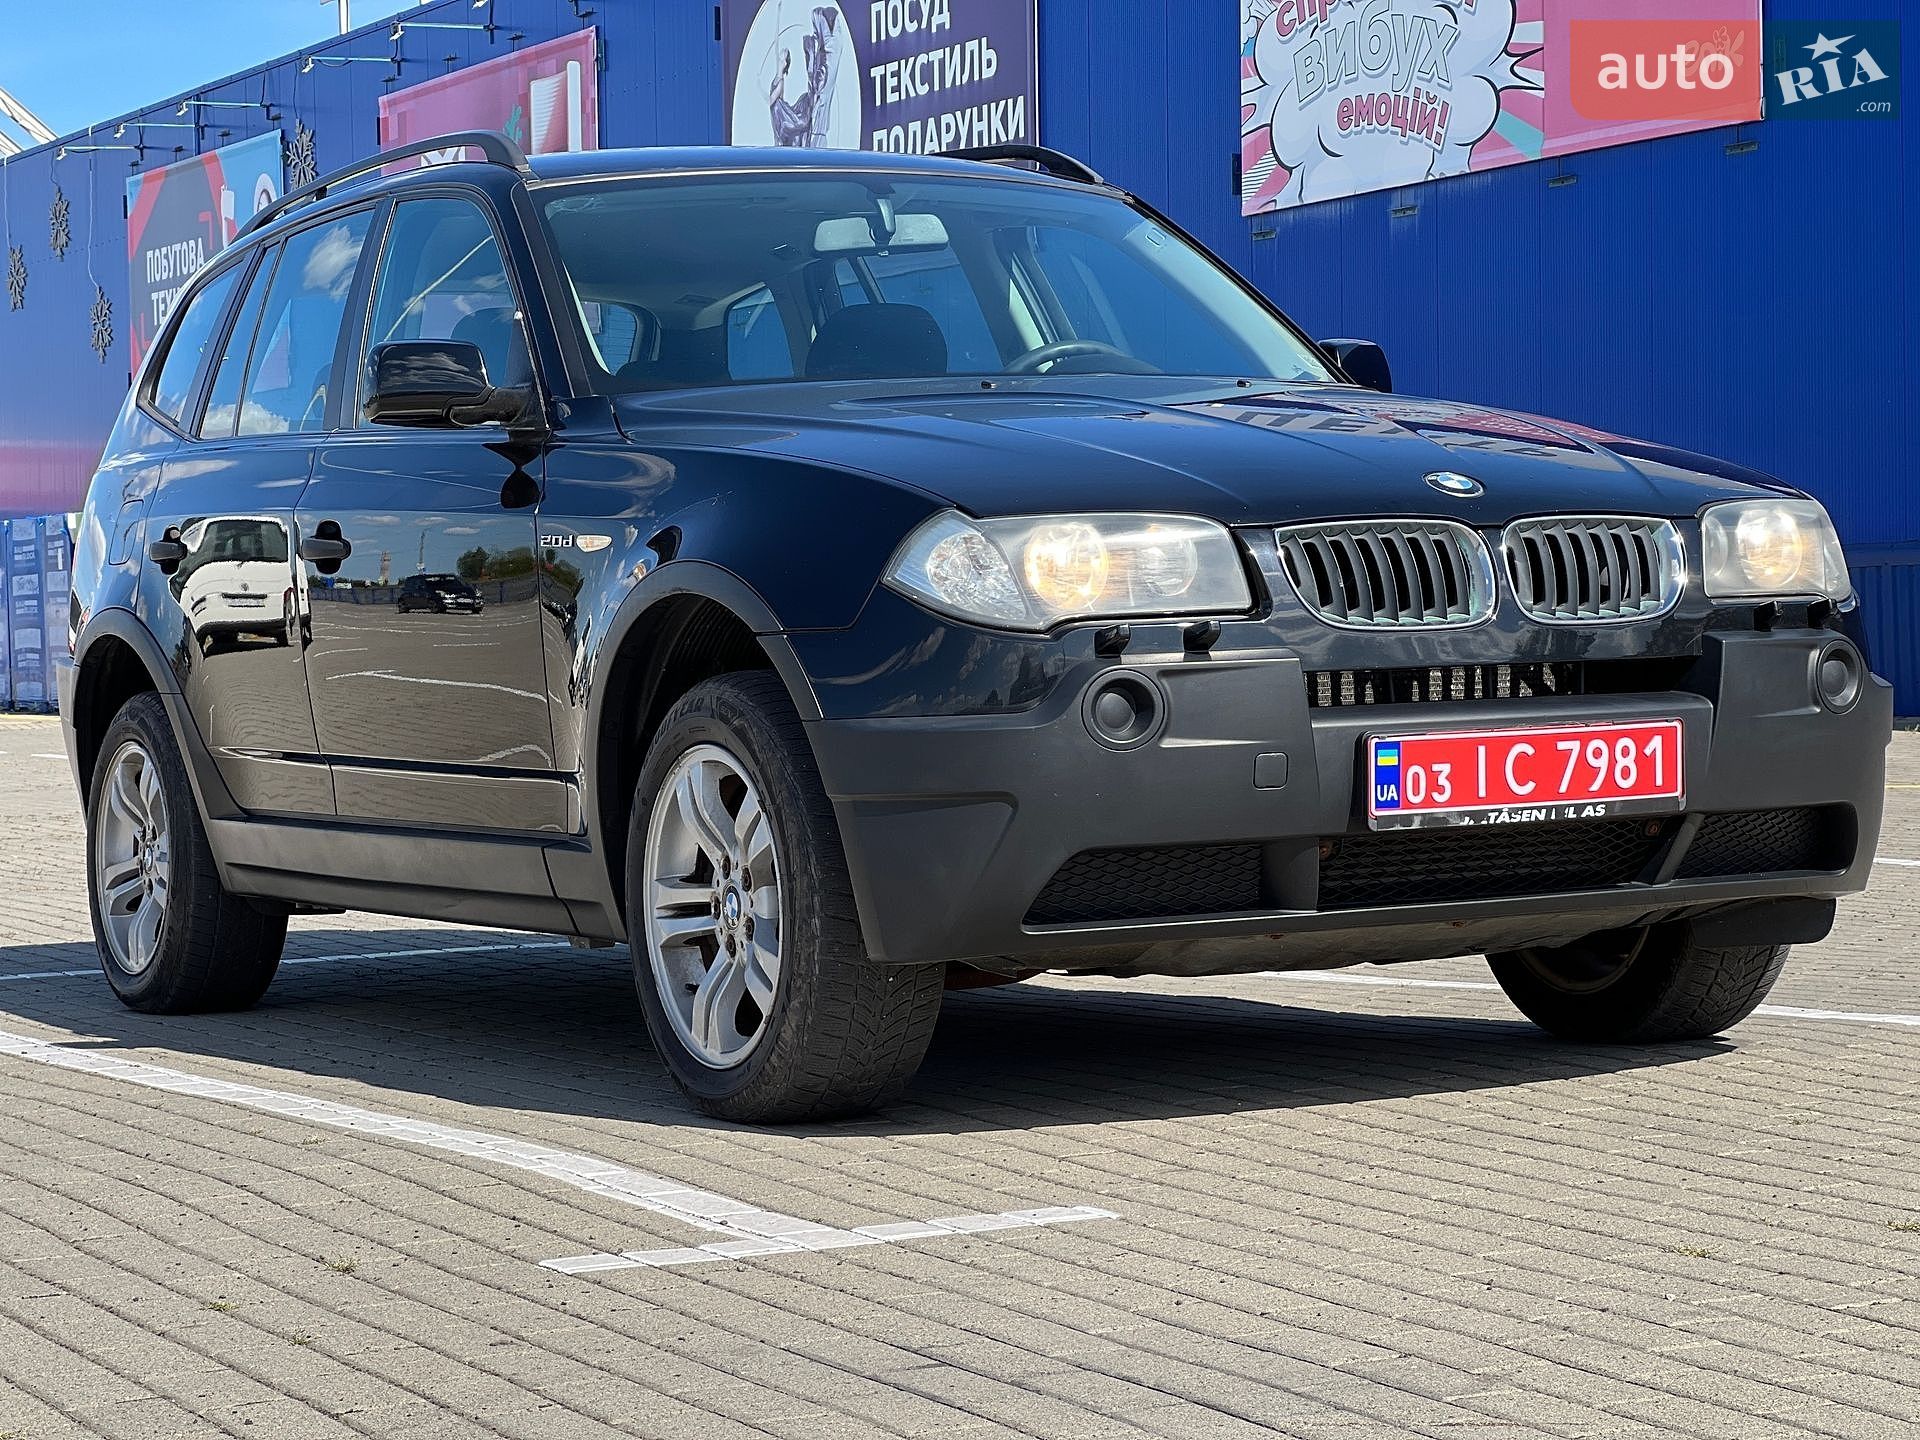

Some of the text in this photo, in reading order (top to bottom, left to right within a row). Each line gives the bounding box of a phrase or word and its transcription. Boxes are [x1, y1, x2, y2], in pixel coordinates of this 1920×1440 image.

[871, 0, 950, 43] ПОСУД
[870, 37, 998, 107] ТЕКСТИЛЬ
[1336, 87, 1450, 146] емоцій!
[146, 237, 205, 283] ПОБУТОВА
[540, 534, 573, 547] 20d
[1405, 734, 1663, 804] 03 IC 7981
[1376, 783, 1399, 802] UA
[1580, 804, 1606, 818] AS
